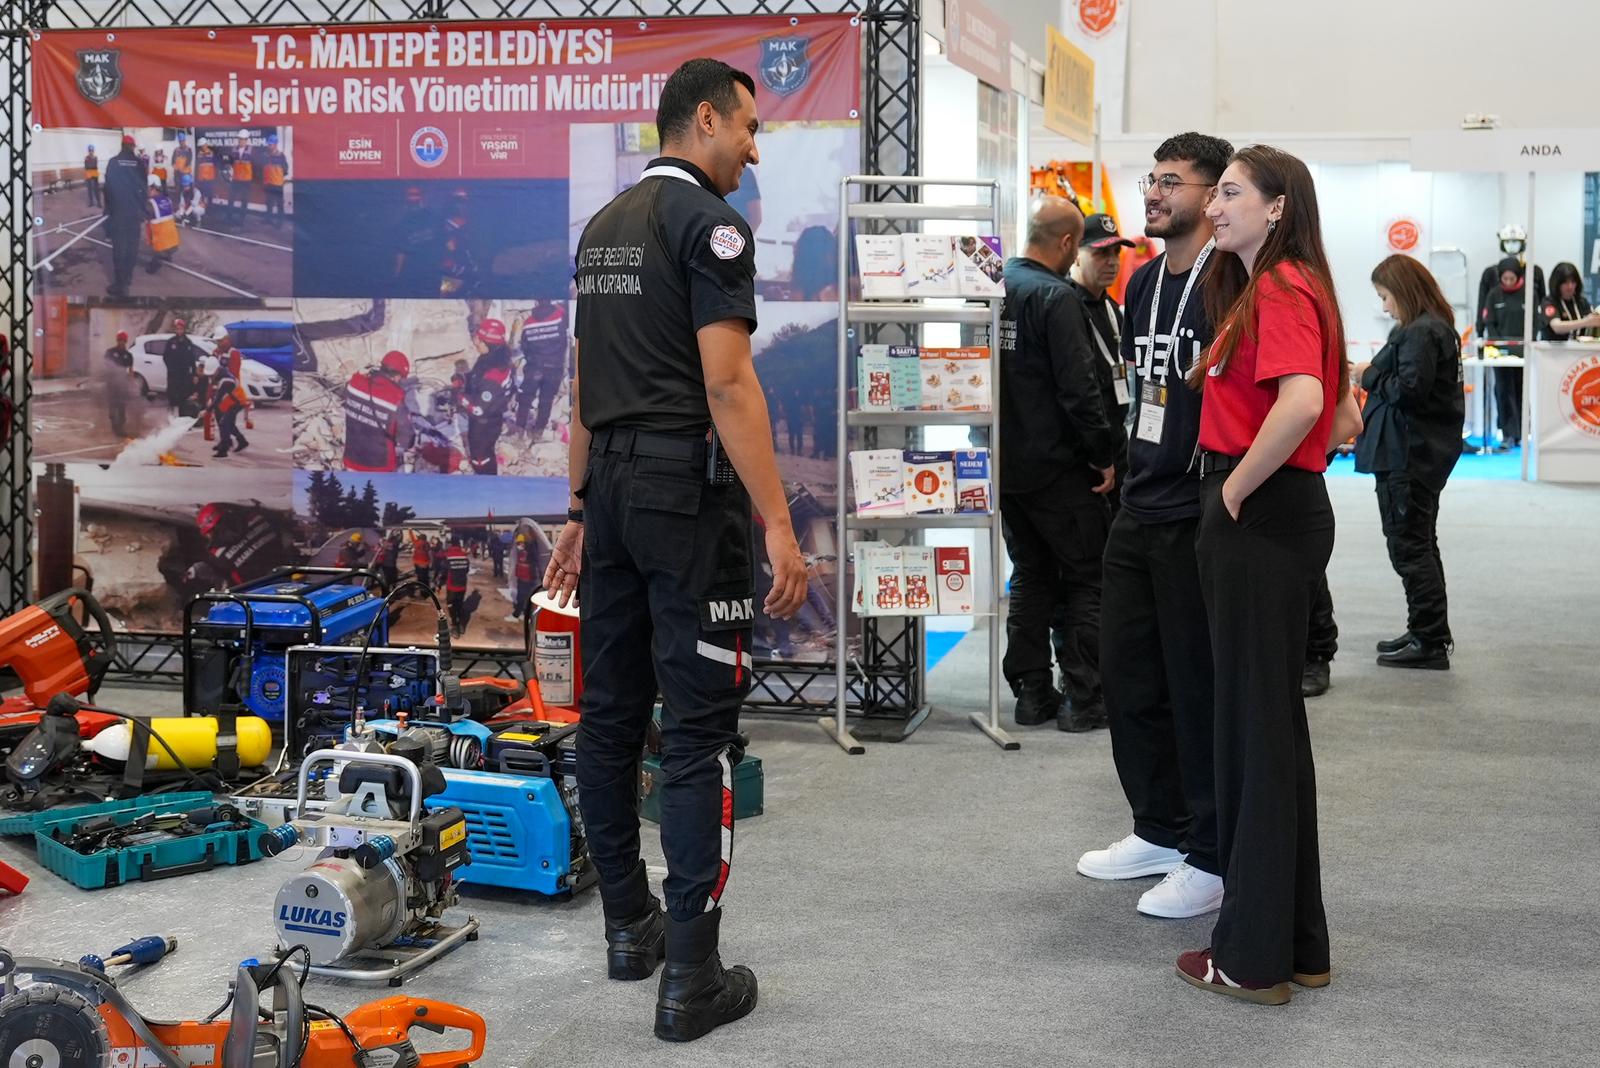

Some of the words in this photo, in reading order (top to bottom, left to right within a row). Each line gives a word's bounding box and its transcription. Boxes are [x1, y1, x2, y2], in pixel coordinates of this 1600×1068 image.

[252, 34, 303, 69] T.C.
[310, 32, 440, 68] MALTEPE
[447, 28, 612, 67] BELEDİYESİ
[770, 41, 797, 51] MAK
[85, 53, 110, 63] MAK
[165, 80, 222, 115] Afet
[229, 73, 299, 121] İşleri
[304, 86, 337, 113] ve
[344, 77, 405, 113] Risk
[411, 75, 538, 113] Yönetimi
[348, 137, 372, 148] ESİN
[339, 148, 382, 161] KÖYMEN
[489, 151, 508, 160] VAR
[1520, 145, 1562, 156] ANDA
[715, 236, 739, 250] KENTSEL
[720, 232, 738, 244] AFAD
[603, 241, 645, 267] BELEDİYESİ
[578, 274, 596, 295] AMA
[597, 273, 643, 295] KURTARMA
[709, 598, 754, 623] MAK
[280, 904, 346, 928] LUKAS
